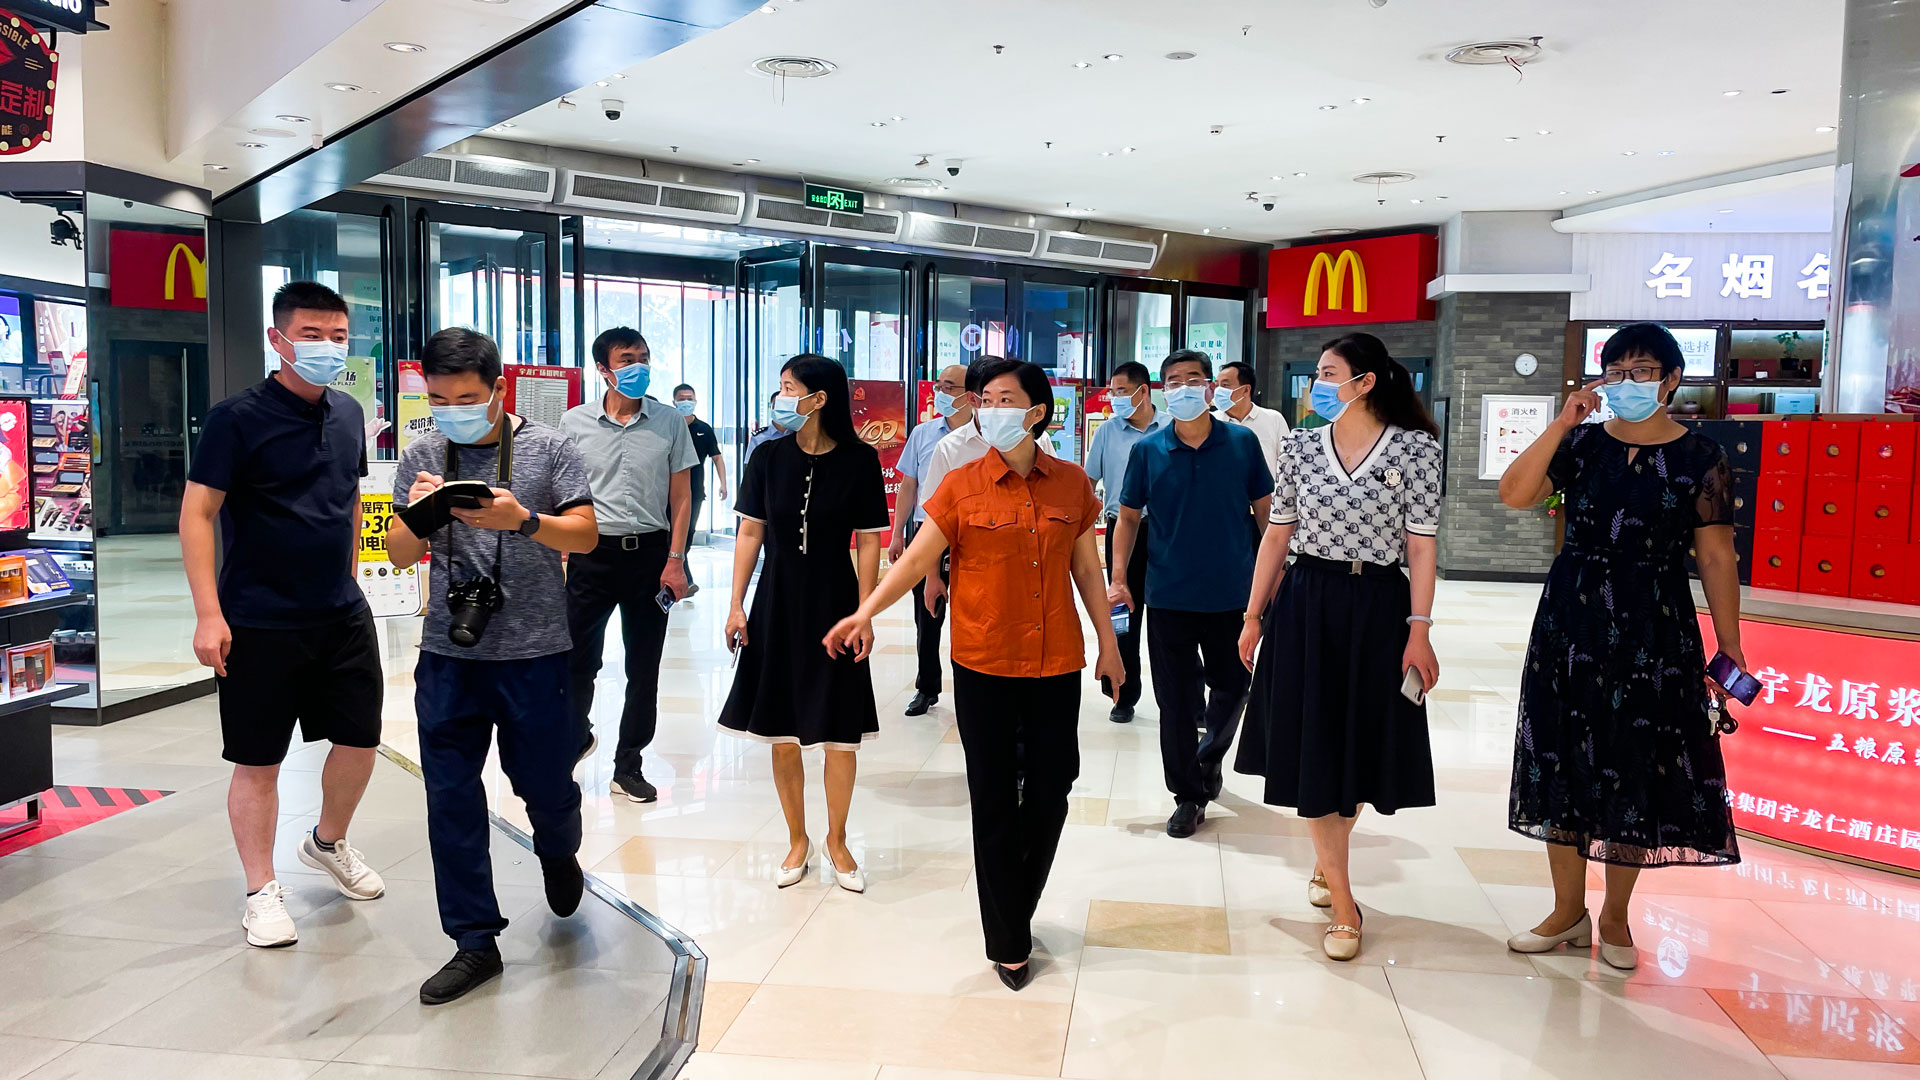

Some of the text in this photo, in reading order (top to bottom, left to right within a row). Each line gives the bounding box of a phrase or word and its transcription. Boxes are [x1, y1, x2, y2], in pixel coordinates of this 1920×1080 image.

[0, 80, 45, 120] 定制
[844, 199, 858, 208] EXIT
[1681, 340, 1710, 352] 选择
[1511, 407, 1538, 416] 消火栓
[1826, 733, 1920, 766] 五粮原
